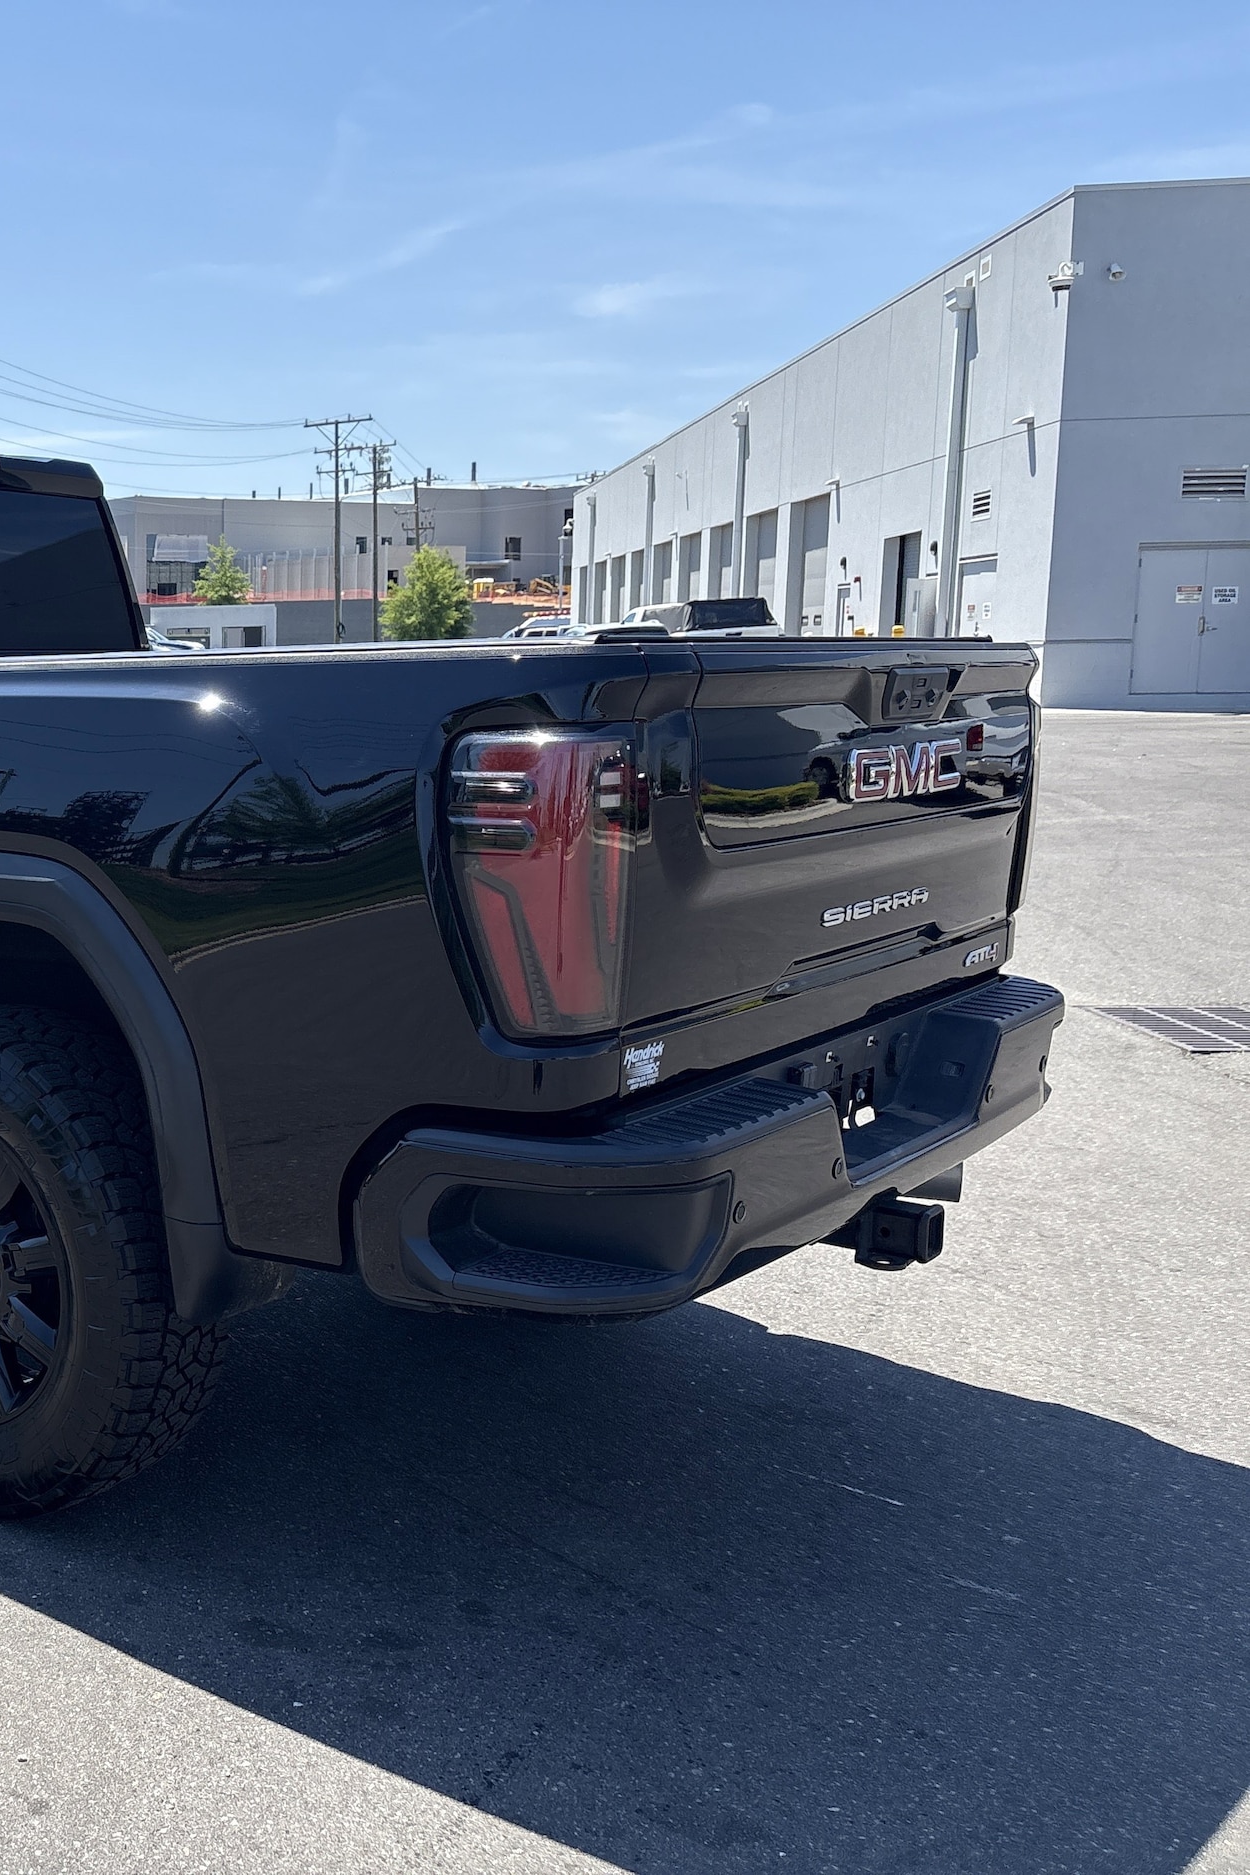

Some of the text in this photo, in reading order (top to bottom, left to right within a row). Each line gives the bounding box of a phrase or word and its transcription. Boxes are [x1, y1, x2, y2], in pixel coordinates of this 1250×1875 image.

[845, 738, 962, 803] GMC
[821, 886, 930, 927] SIERRA
[964, 942, 999, 967] AT4
[624, 1041, 664, 1068] Hendrick
